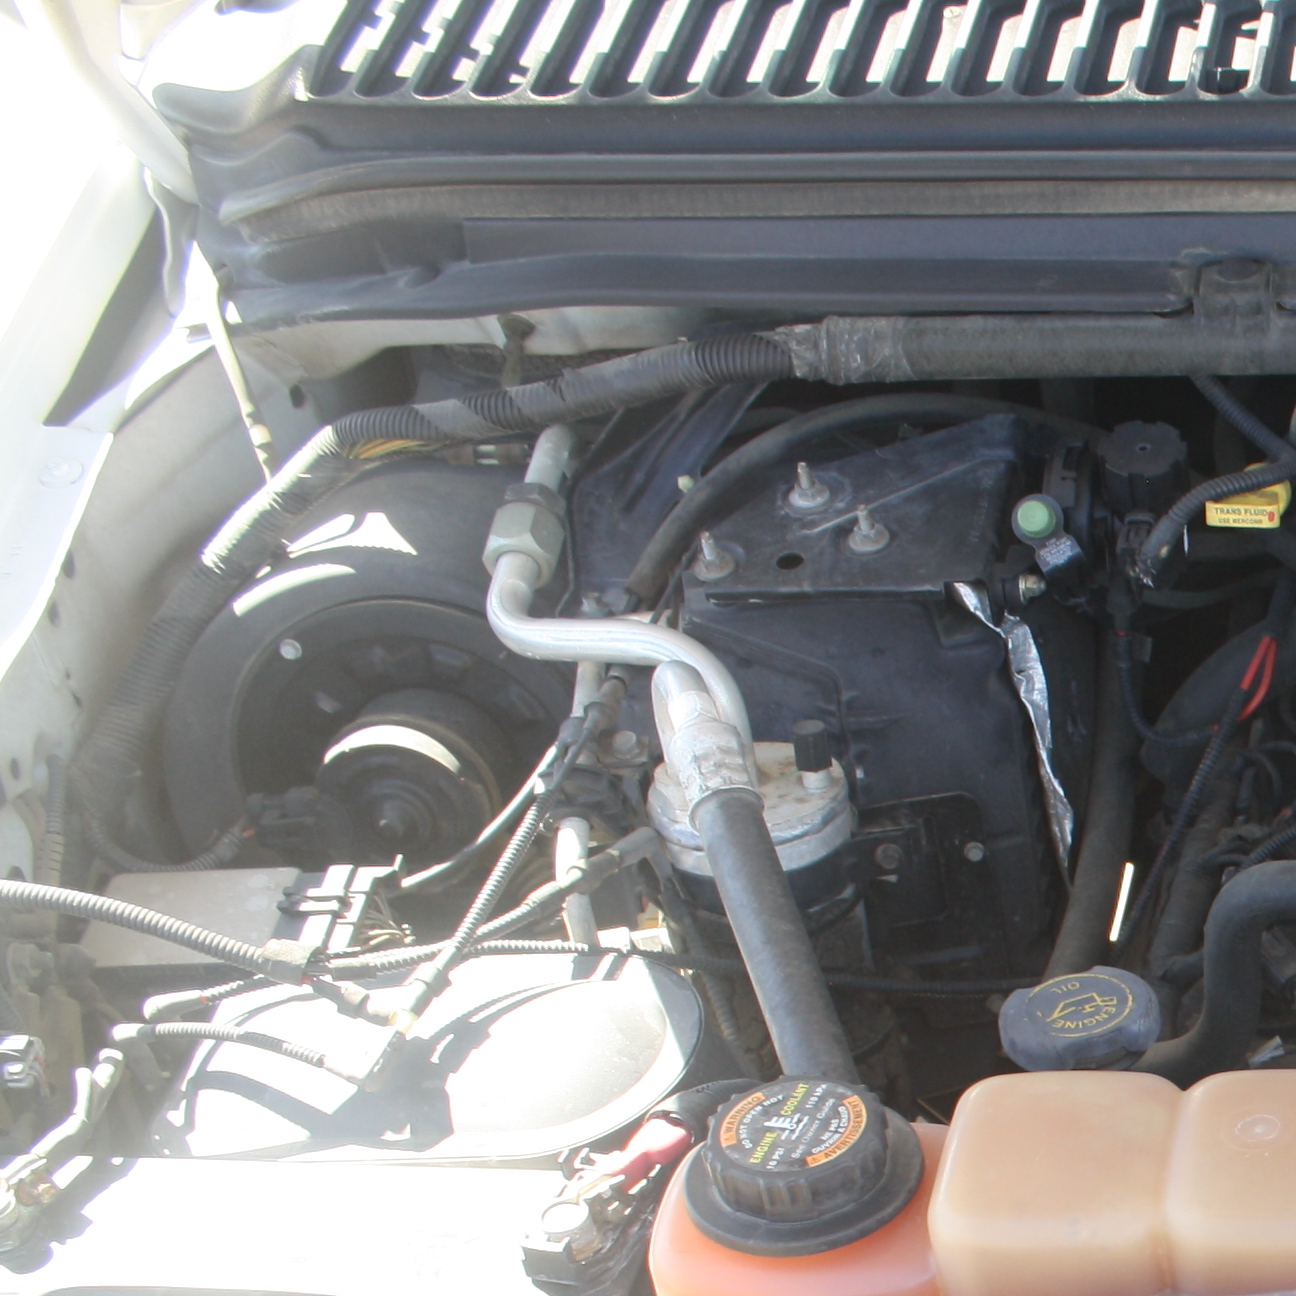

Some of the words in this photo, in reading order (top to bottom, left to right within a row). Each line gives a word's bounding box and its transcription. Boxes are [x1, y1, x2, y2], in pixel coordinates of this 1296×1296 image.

[1214, 507, 1242, 515] TRANS
[1244, 508, 1268, 516] FLUID
[1050, 981, 1080, 994] OIL
[1052, 1006, 1117, 1029] ENGINE
[762, 1094, 783, 1106] HOT
[724, 1095, 759, 1133] WARNING
[743, 1105, 763, 1124] OPEN
[750, 1131, 778, 1164] ENGINE
[780, 1083, 810, 1115] COOLANT
[823, 1100, 863, 1158] AVERTISSEMENT
[739, 1125, 748, 1139] NOT
[741, 1139, 753, 1149] DO
